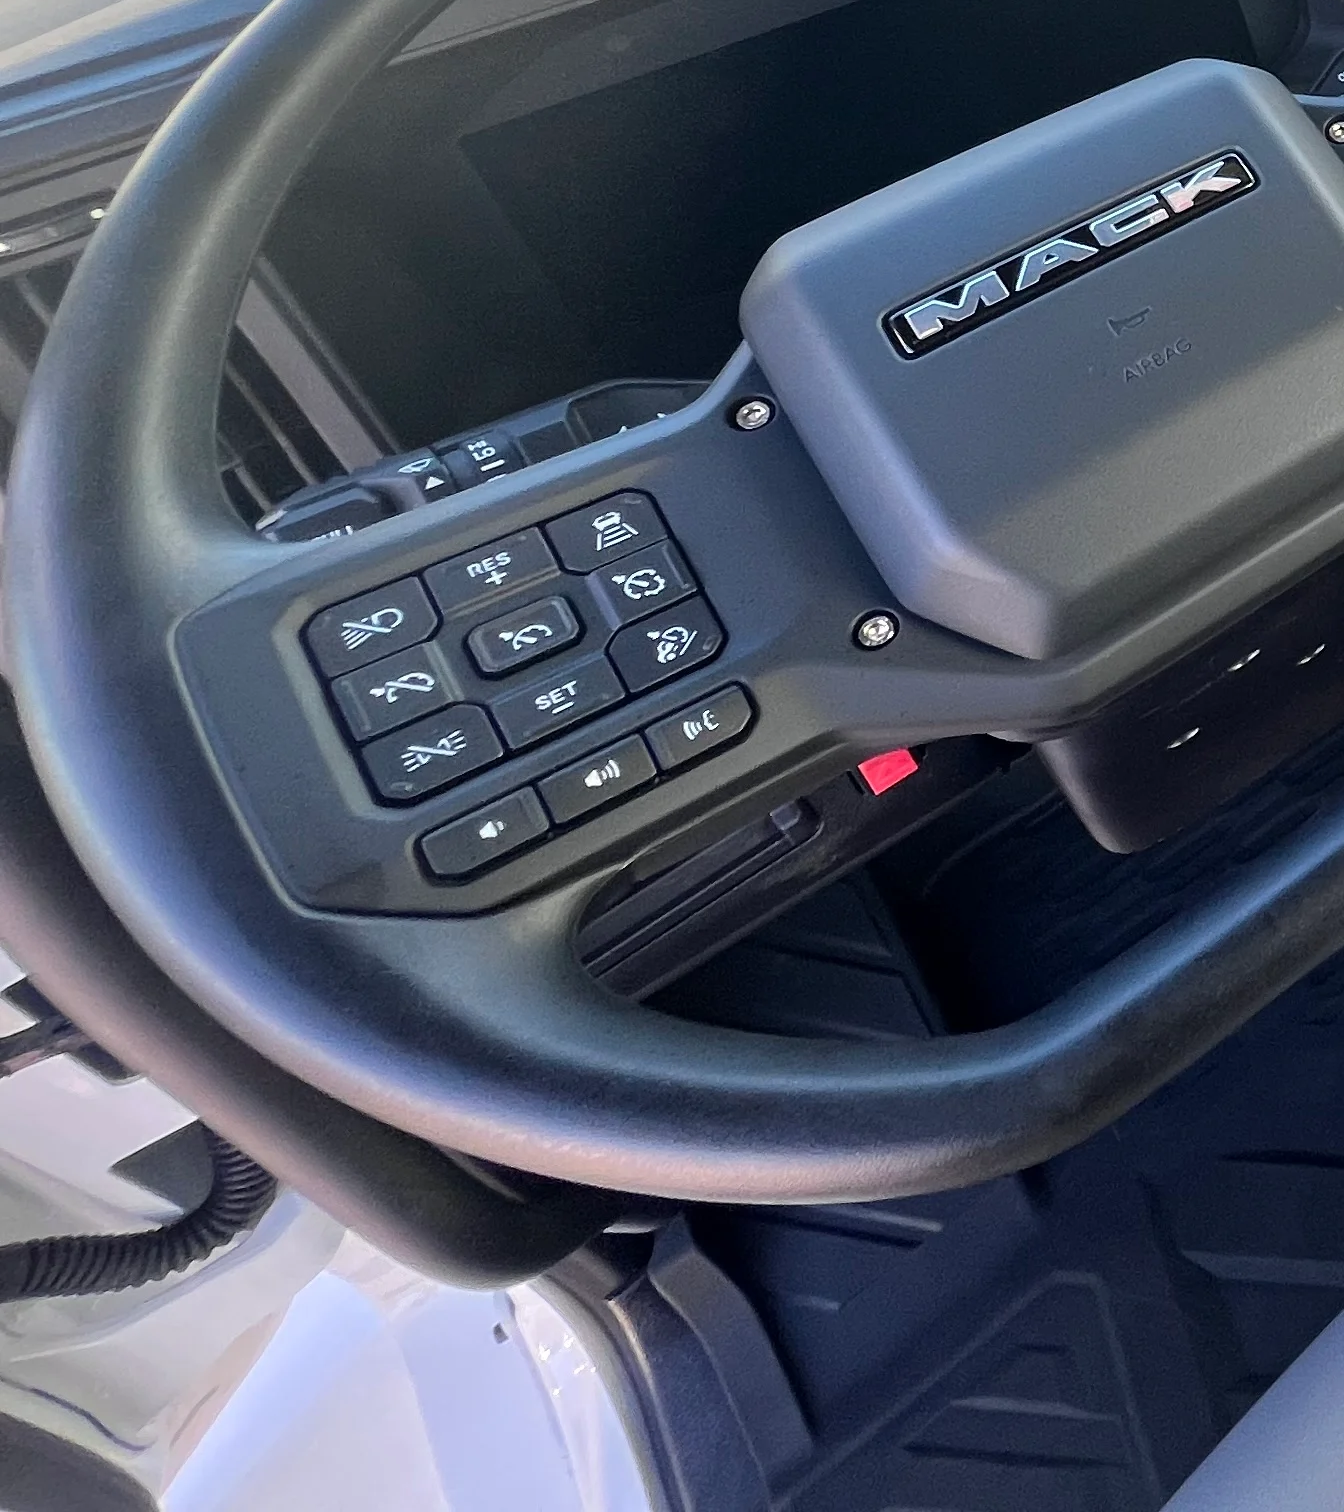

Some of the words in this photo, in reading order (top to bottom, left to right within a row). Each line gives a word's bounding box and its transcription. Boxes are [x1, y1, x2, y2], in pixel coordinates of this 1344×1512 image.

[904, 160, 1242, 340] MACK
[1122, 338, 1193, 384] AIRBAG
[467, 551, 512, 577] RES
[534, 680, 580, 710] SET
